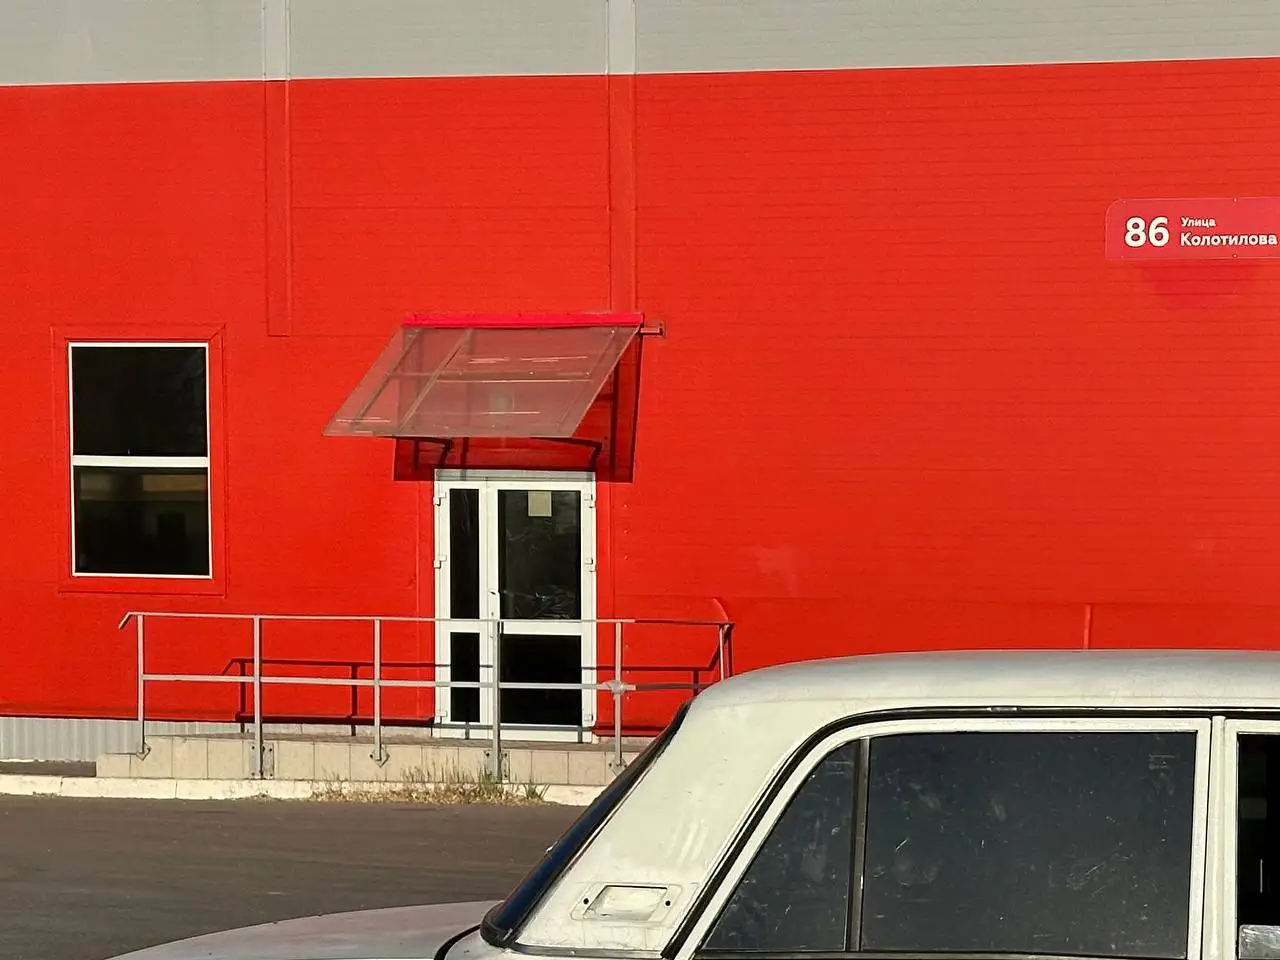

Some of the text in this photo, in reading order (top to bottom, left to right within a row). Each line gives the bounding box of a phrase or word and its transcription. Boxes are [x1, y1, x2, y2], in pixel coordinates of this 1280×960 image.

[1180, 217, 1216, 228] Улица
[1125, 216, 1170, 247] 86
[1180, 233, 1278, 247] Колотилова
